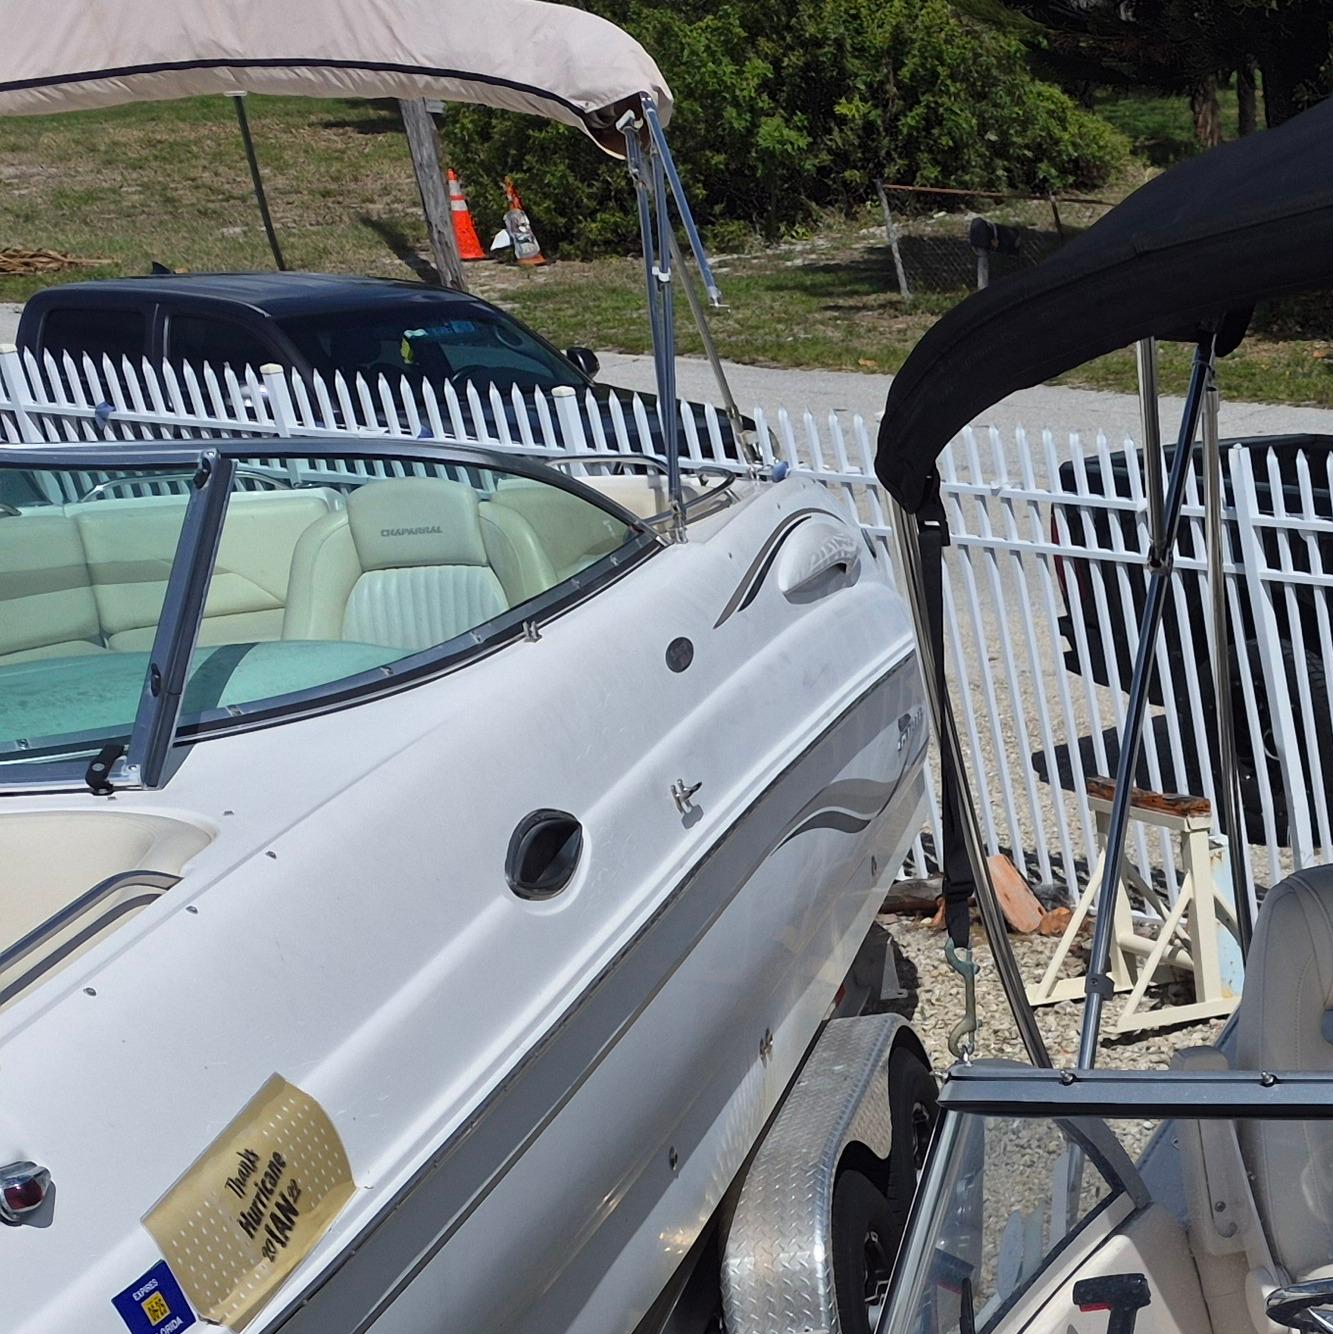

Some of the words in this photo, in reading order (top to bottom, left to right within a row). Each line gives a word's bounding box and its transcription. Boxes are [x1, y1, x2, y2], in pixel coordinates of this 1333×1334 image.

[225, 1149, 259, 1199] Thanks
[238, 1152, 286, 1239] Hurricane
[264, 1191, 299, 1248] IAN
